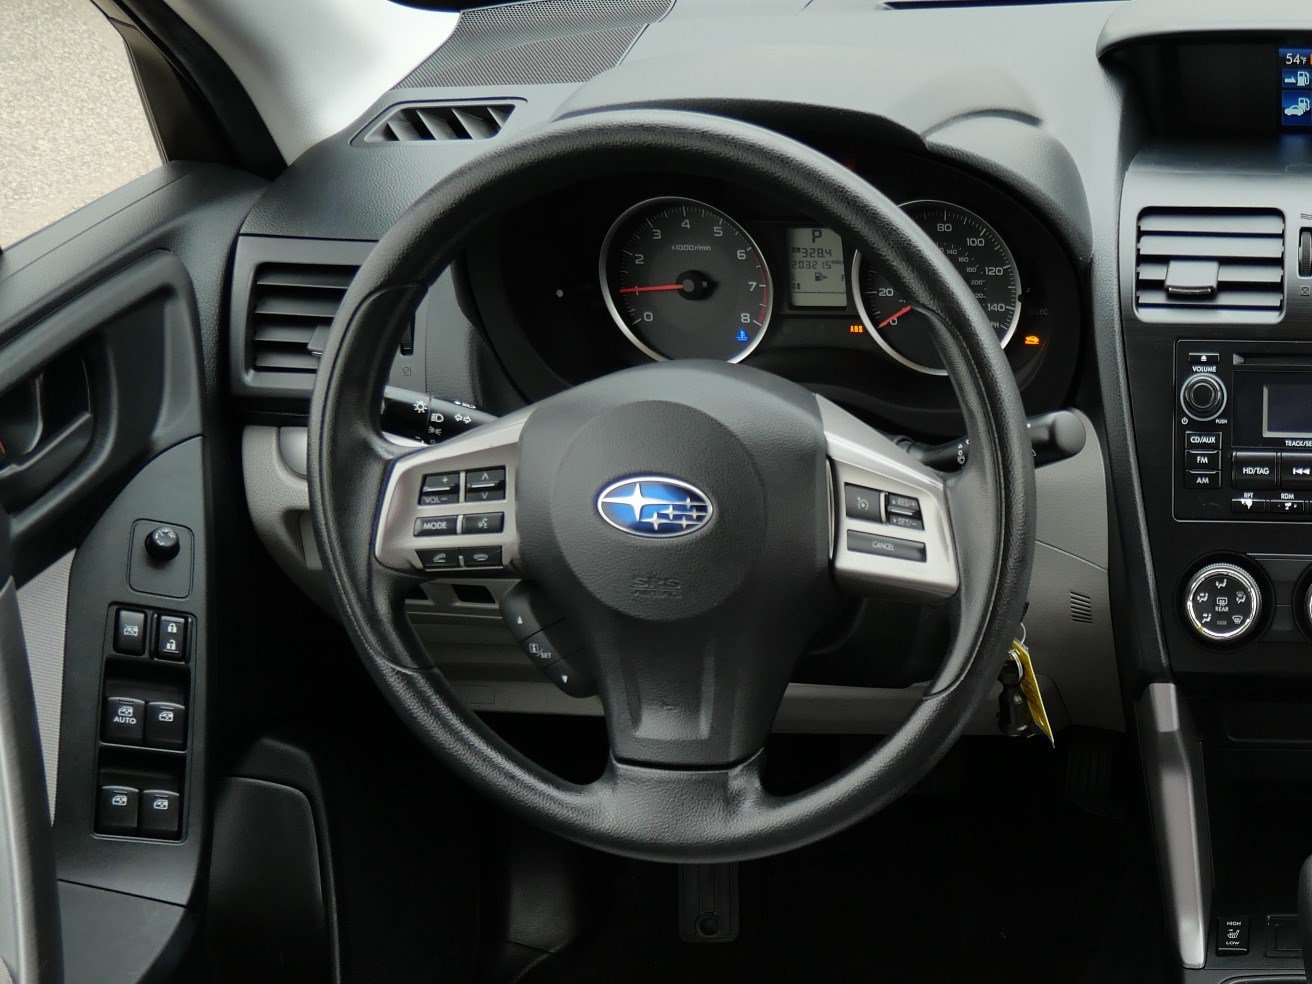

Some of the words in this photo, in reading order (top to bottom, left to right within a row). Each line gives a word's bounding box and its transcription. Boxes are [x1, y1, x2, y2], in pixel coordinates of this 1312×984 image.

[681, 219, 691, 229] 4
[936, 223, 952, 232] 80
[652, 229, 661, 239] 3
[713, 226, 723, 237] 5
[812, 229, 822, 243] P
[966, 237, 985, 247] 100
[635, 254, 644, 264] 2
[736, 249, 746, 260] 6
[984, 266, 1004, 276] 120
[748, 281, 757, 292] 7
[878, 288, 894, 297] 20
[987, 302, 1006, 312] 140
[644, 312, 653, 322] 0
[740, 313, 750, 323] 8
[890, 318, 898, 326] 0
[850, 325, 863, 333] ABS
[1190, 436, 1215, 444] CD/AUX
[1242, 467, 1269, 475] HD/TAG
[423, 521, 447, 530] MODE
[872, 540, 895, 551] CANCEL
[113, 716, 137, 725] AUTO
